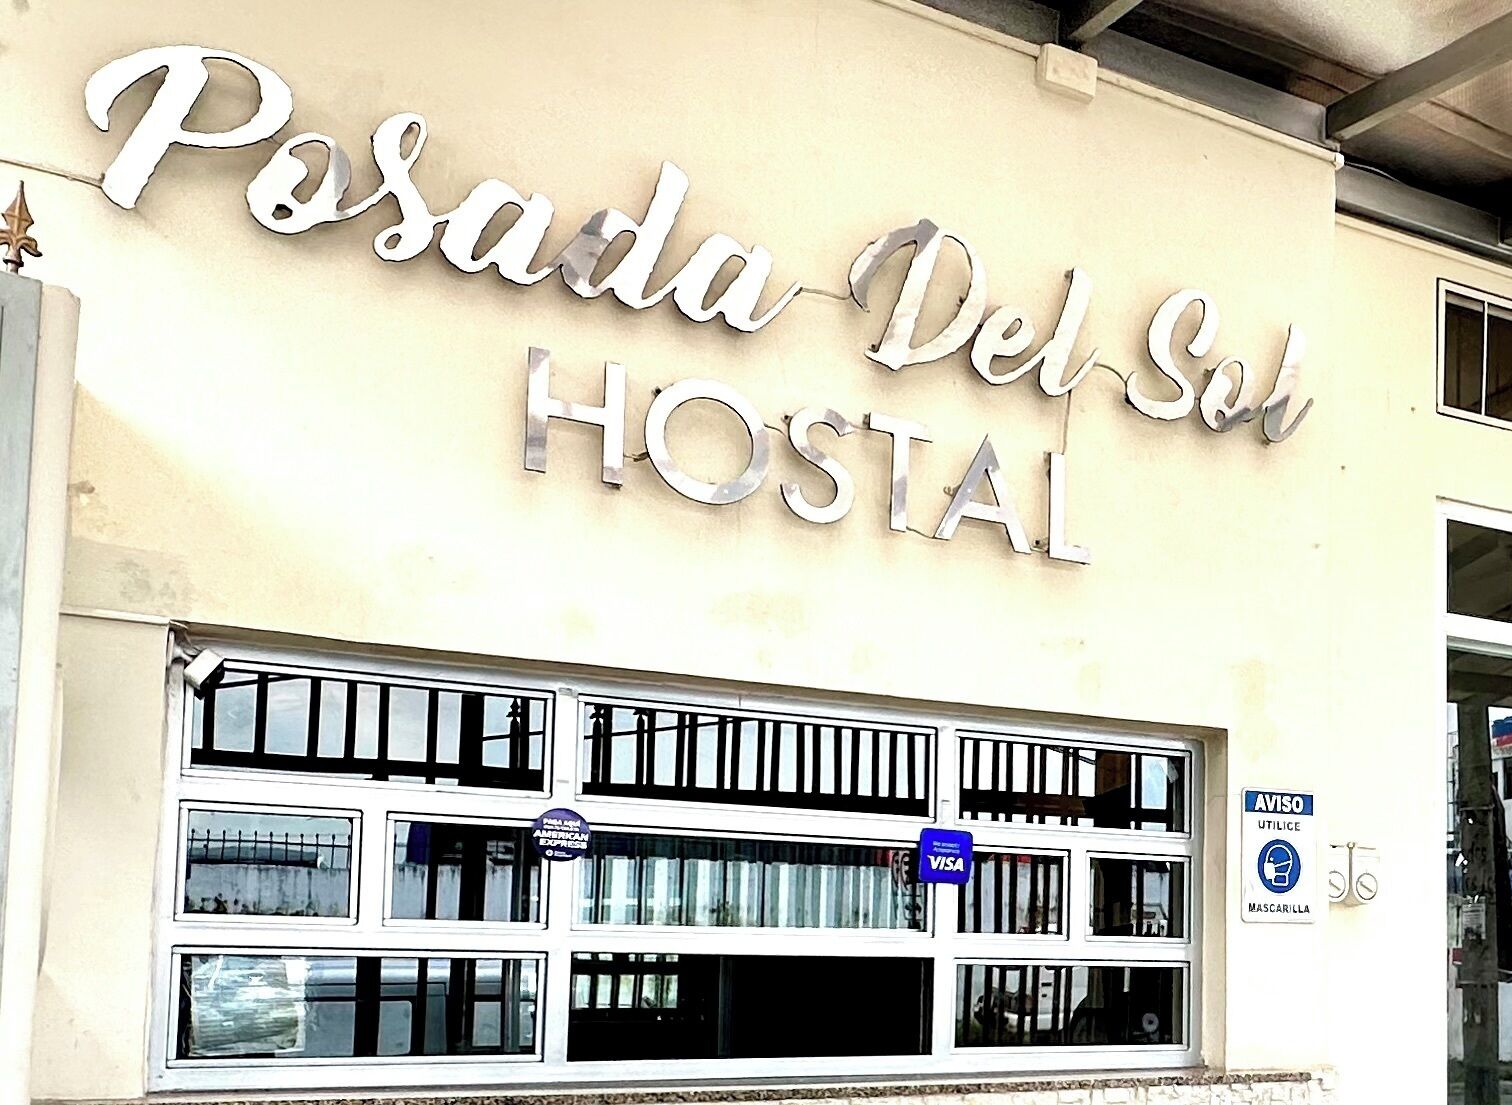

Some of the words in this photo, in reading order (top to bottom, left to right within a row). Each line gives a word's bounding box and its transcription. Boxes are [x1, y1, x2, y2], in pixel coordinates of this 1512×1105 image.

[84, 44, 803, 333] Posada
[849, 219, 1100, 397] Del
[1125, 288, 1316, 443] Sol
[523, 346, 1092, 565] HOSTAL
[1254, 793, 1304, 813] AVISO
[1258, 820, 1301, 832] UTILICE
[532, 829, 589, 842] AMERICAN
[538, 838, 588, 850] EXPRESS
[926, 854, 964, 872] VISA
[1248, 903, 1310, 914] MASCARILLA
